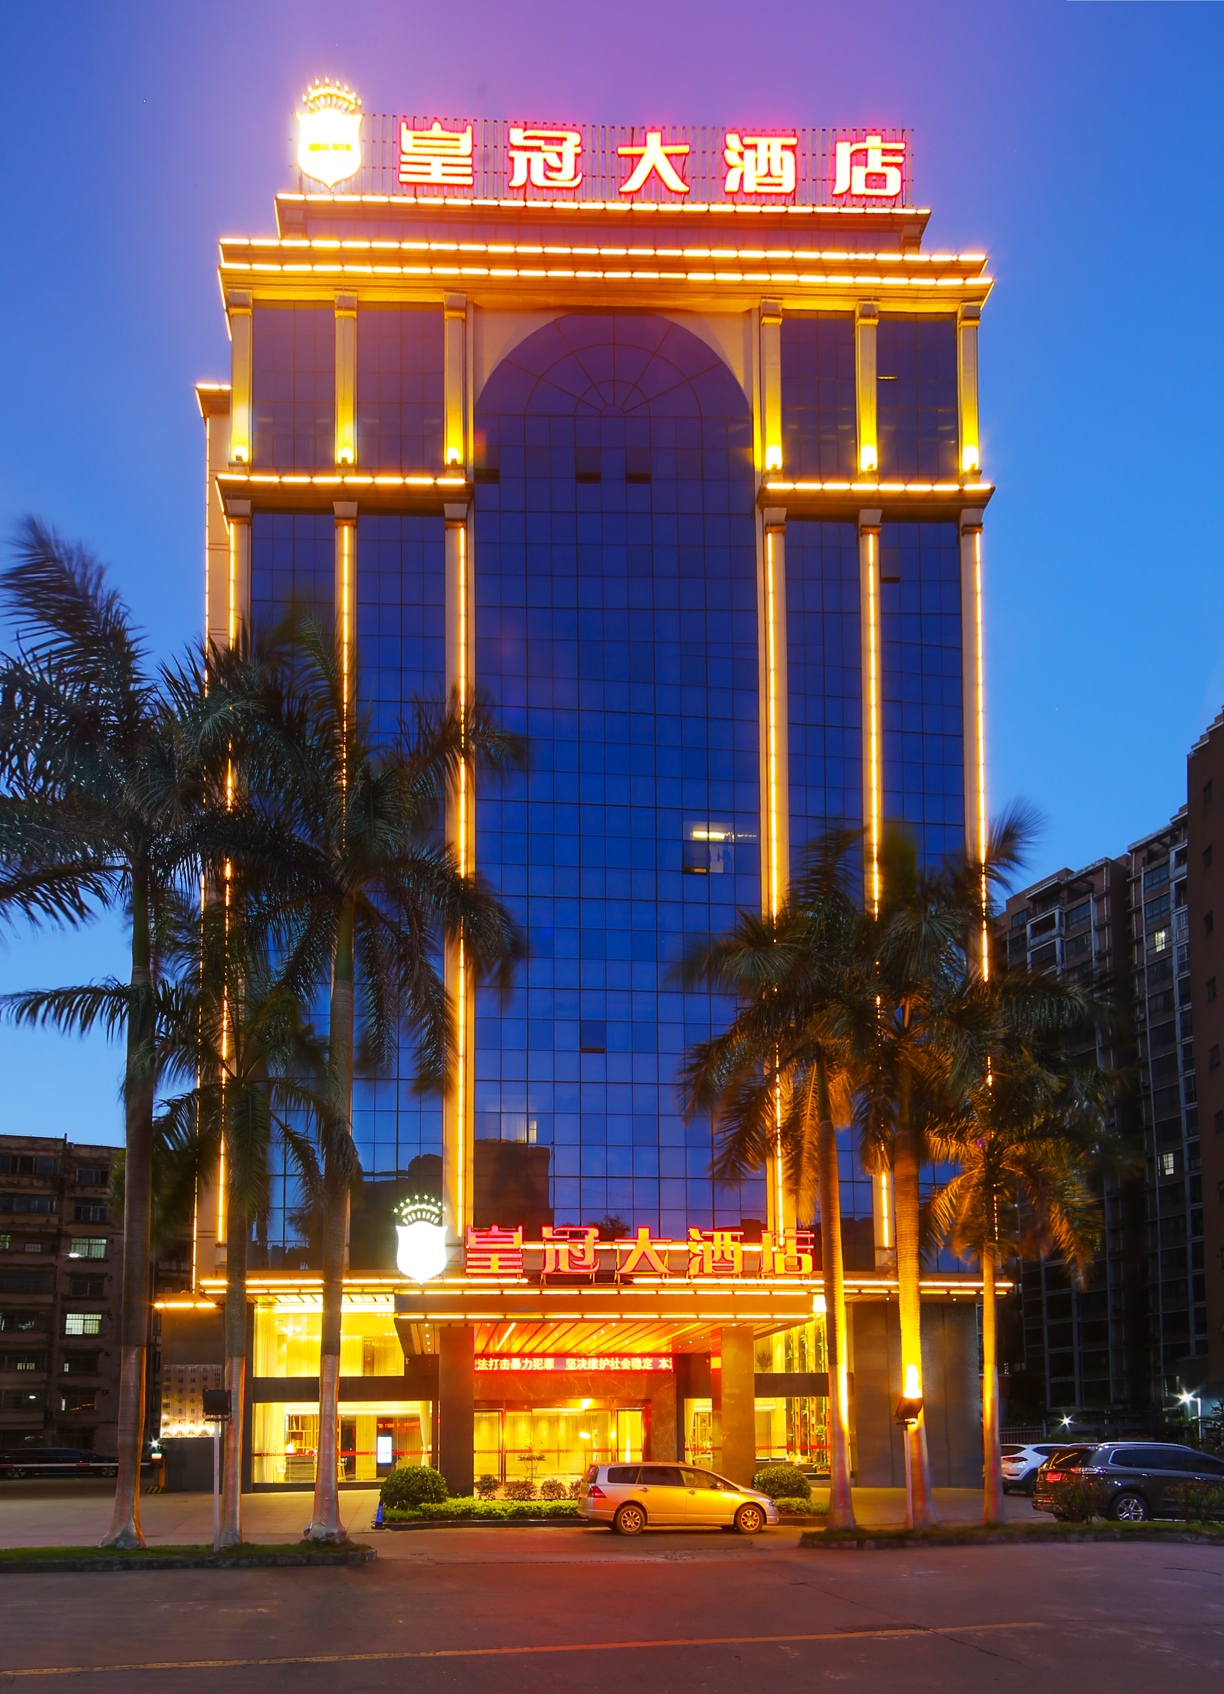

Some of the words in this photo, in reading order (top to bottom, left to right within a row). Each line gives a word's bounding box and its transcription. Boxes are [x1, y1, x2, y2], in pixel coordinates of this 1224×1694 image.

[398, 120, 907, 197] 皇冠大酒店
[465, 1224, 815, 1275] 皇冠大酒店
[474, 1357, 555, 1370] 法打击暴力犯罪
[565, 1357, 653, 1370] 坚决维护社会稳定
